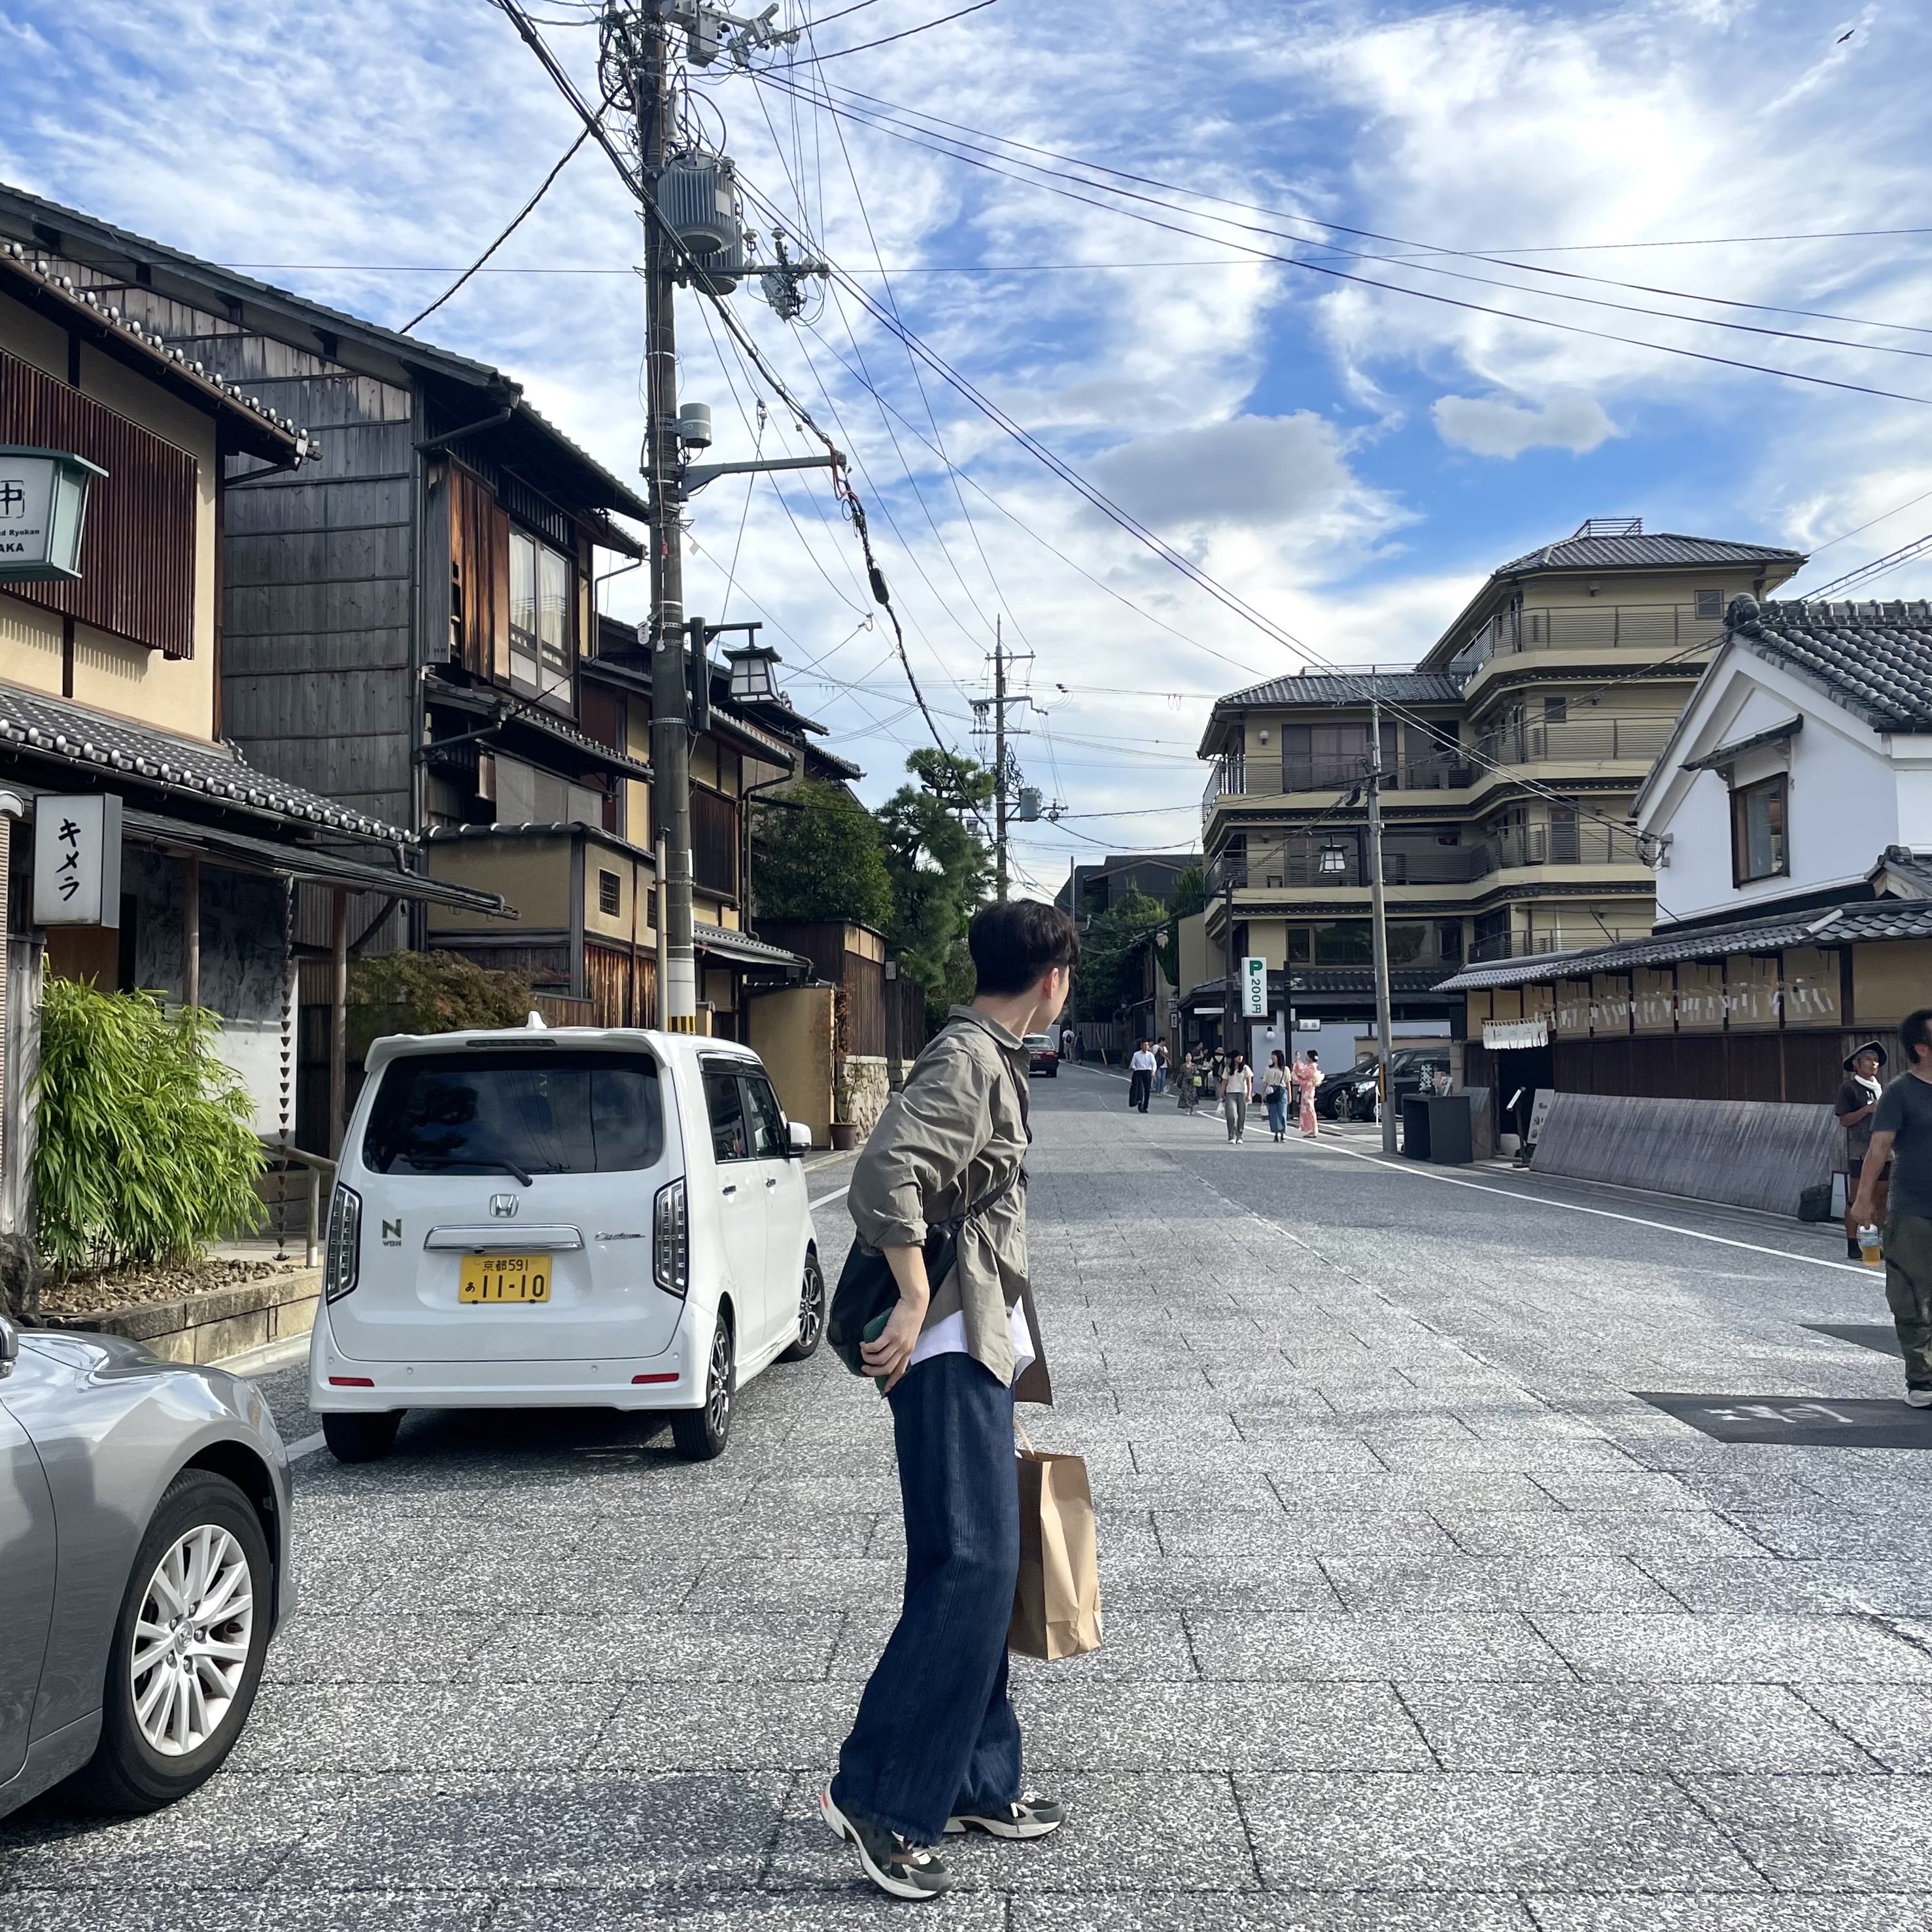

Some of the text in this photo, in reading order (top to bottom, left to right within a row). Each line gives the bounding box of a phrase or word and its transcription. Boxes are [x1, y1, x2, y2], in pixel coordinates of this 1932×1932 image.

[56, 818, 81, 901] キメラ
[1249, 960, 1263, 1014] P 200円
[382, 1218, 402, 1239] N
[482, 1274, 545, 1298] 11-10
